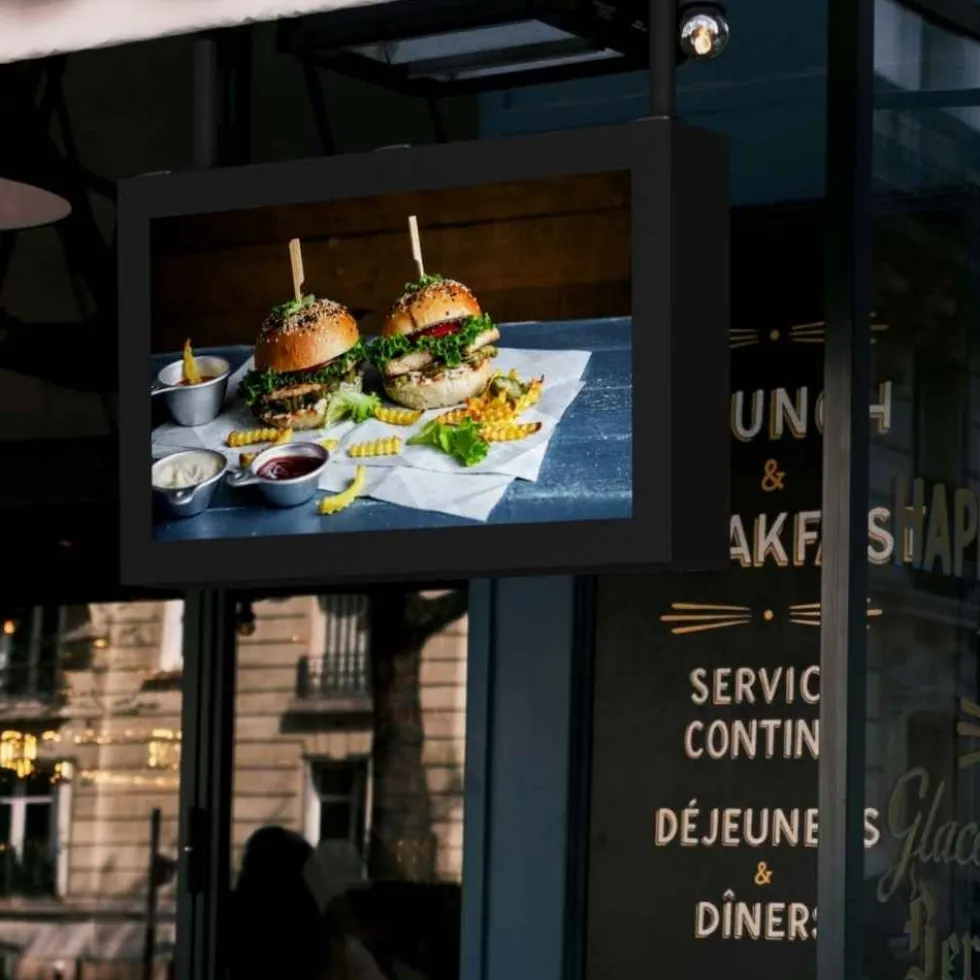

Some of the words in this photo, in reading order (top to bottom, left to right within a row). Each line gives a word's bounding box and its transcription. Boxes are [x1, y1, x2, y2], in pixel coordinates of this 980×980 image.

[730, 380, 892, 442] UNH
[761, 459, 785, 492] &
[729, 505, 926, 567] AKFST
[689, 665, 821, 706] SERVIC
[684, 719, 821, 760] CONTIN
[654, 798, 881, 848] DÉJEUNES
[753, 860, 774, 886] &
[694, 887, 818, 941] DÎNER
